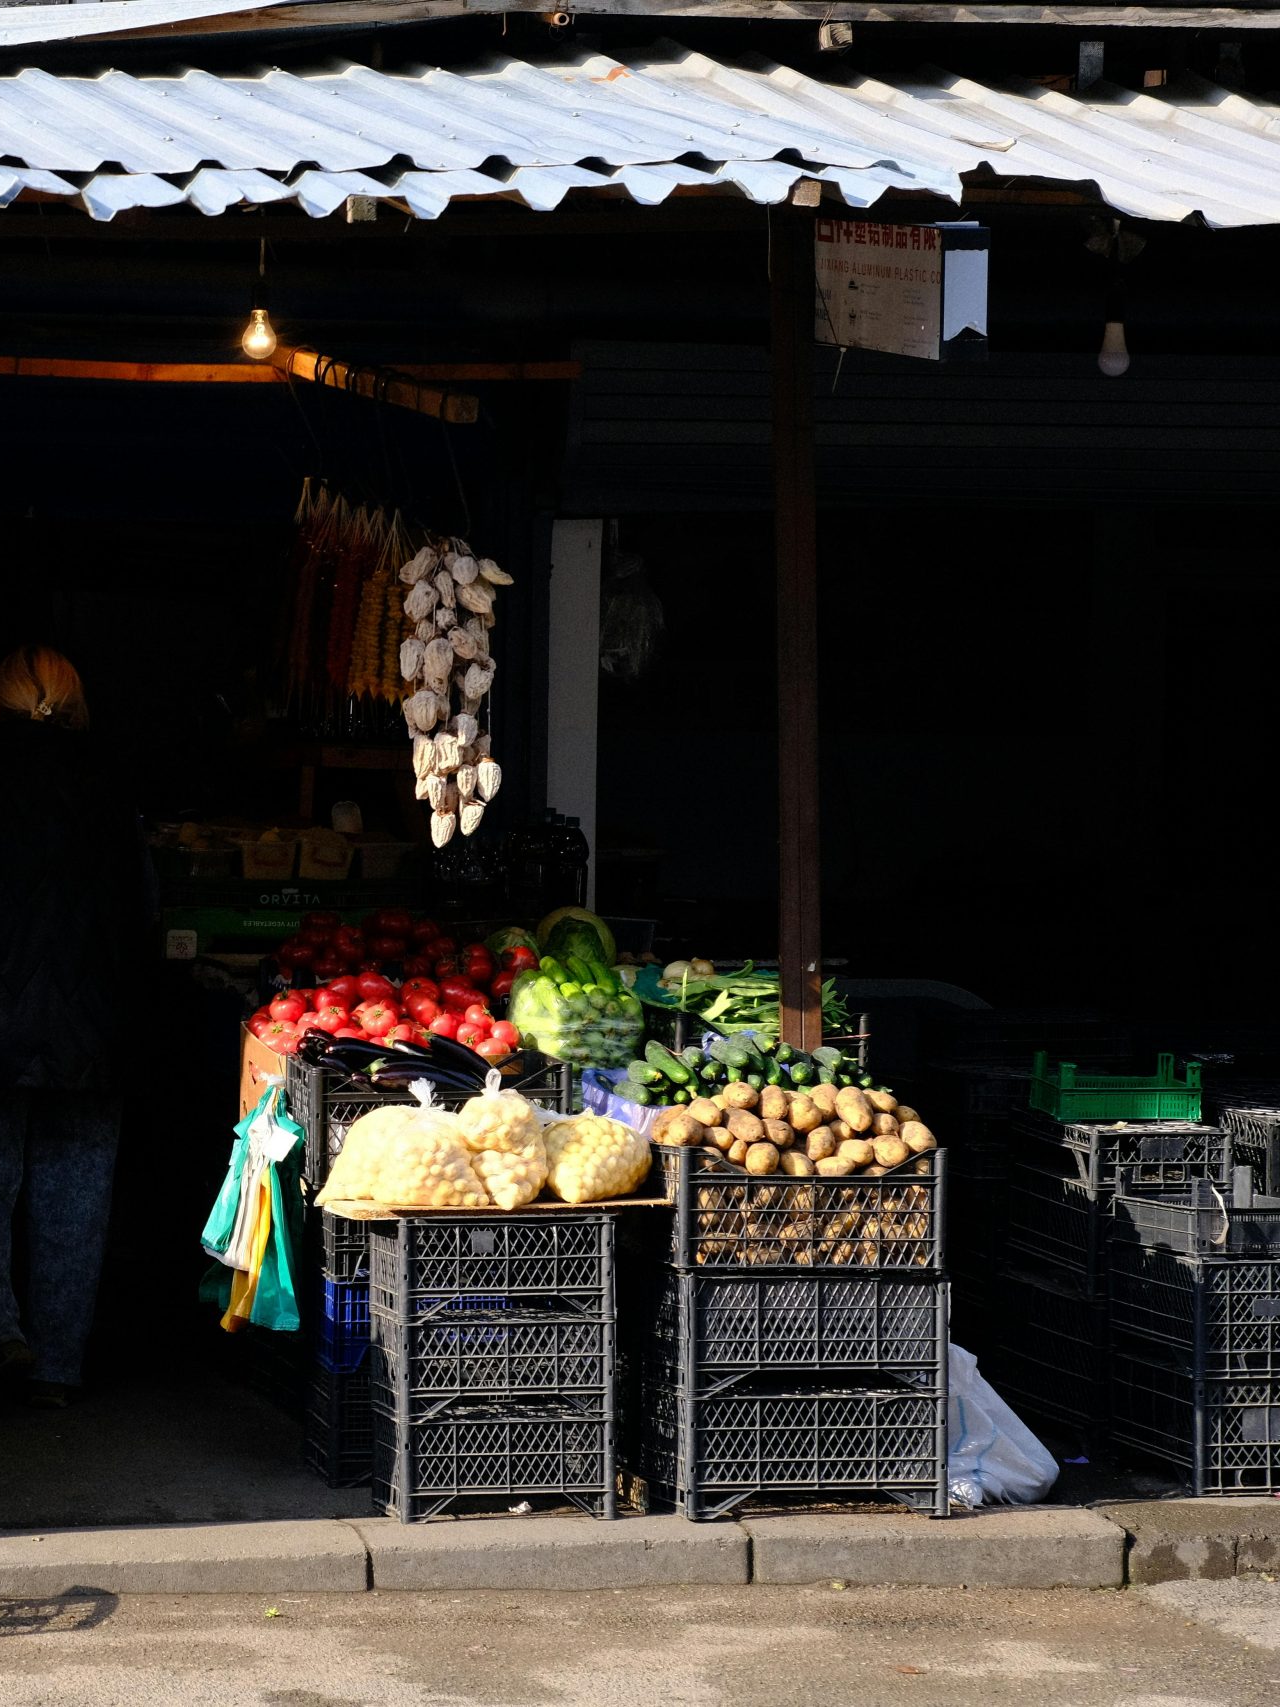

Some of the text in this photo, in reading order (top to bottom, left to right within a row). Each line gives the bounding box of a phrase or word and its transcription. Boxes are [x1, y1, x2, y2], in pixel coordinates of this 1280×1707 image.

[820, 258, 849, 273] JIXIANG
[852, 261, 891, 279] ALUMINUM
[894, 265, 927, 282] PLASTIC
[259, 894, 320, 905] ORVITA
[242, 920, 285, 928] VEGETABLES
